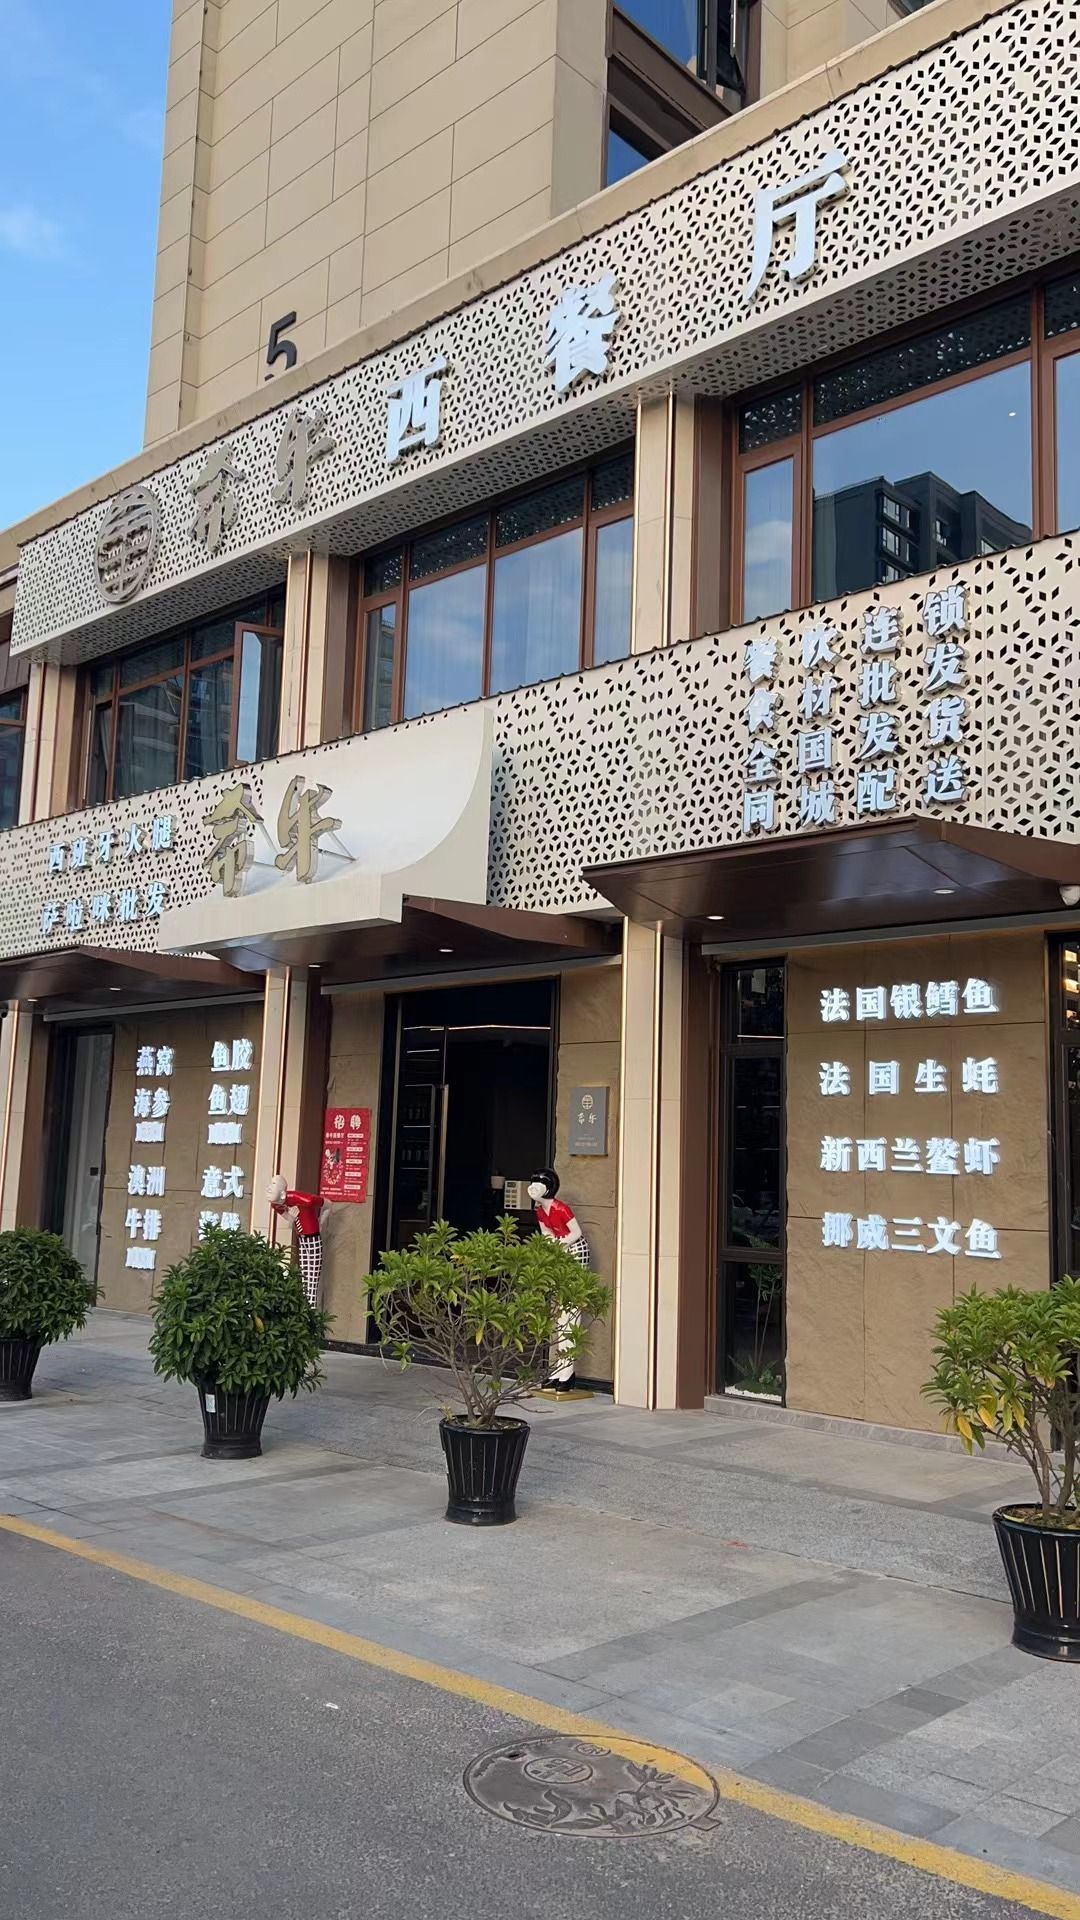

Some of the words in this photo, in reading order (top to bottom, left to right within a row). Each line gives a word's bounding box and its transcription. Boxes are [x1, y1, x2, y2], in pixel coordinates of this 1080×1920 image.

[386, 149, 850, 466] 西餐厅
[264, 309, 297, 381] 5
[744, 585, 968, 684] 餐饮连锁
[745, 642, 970, 733] 食材批发
[743, 696, 968, 785] 全国发货
[743, 753, 969, 834] 同城配送
[49, 815, 174, 875] 西班牙火腿
[820, 978, 999, 1022] 法国银鳕鱼
[136, 1046, 175, 1077] 燕窝
[211, 1038, 253, 1073] 鱼胶
[819, 1057, 999, 1095] 法国生蚝
[133, 1087, 171, 1119] 海参
[208, 1083, 250, 1116] 鱼翅
[127, 1165, 166, 1197] 澳洲
[201, 1165, 244, 1198] 意式
[125, 1208, 162, 1241] 牛排
[821, 1211, 1002, 1259] 挪威三文鱼
